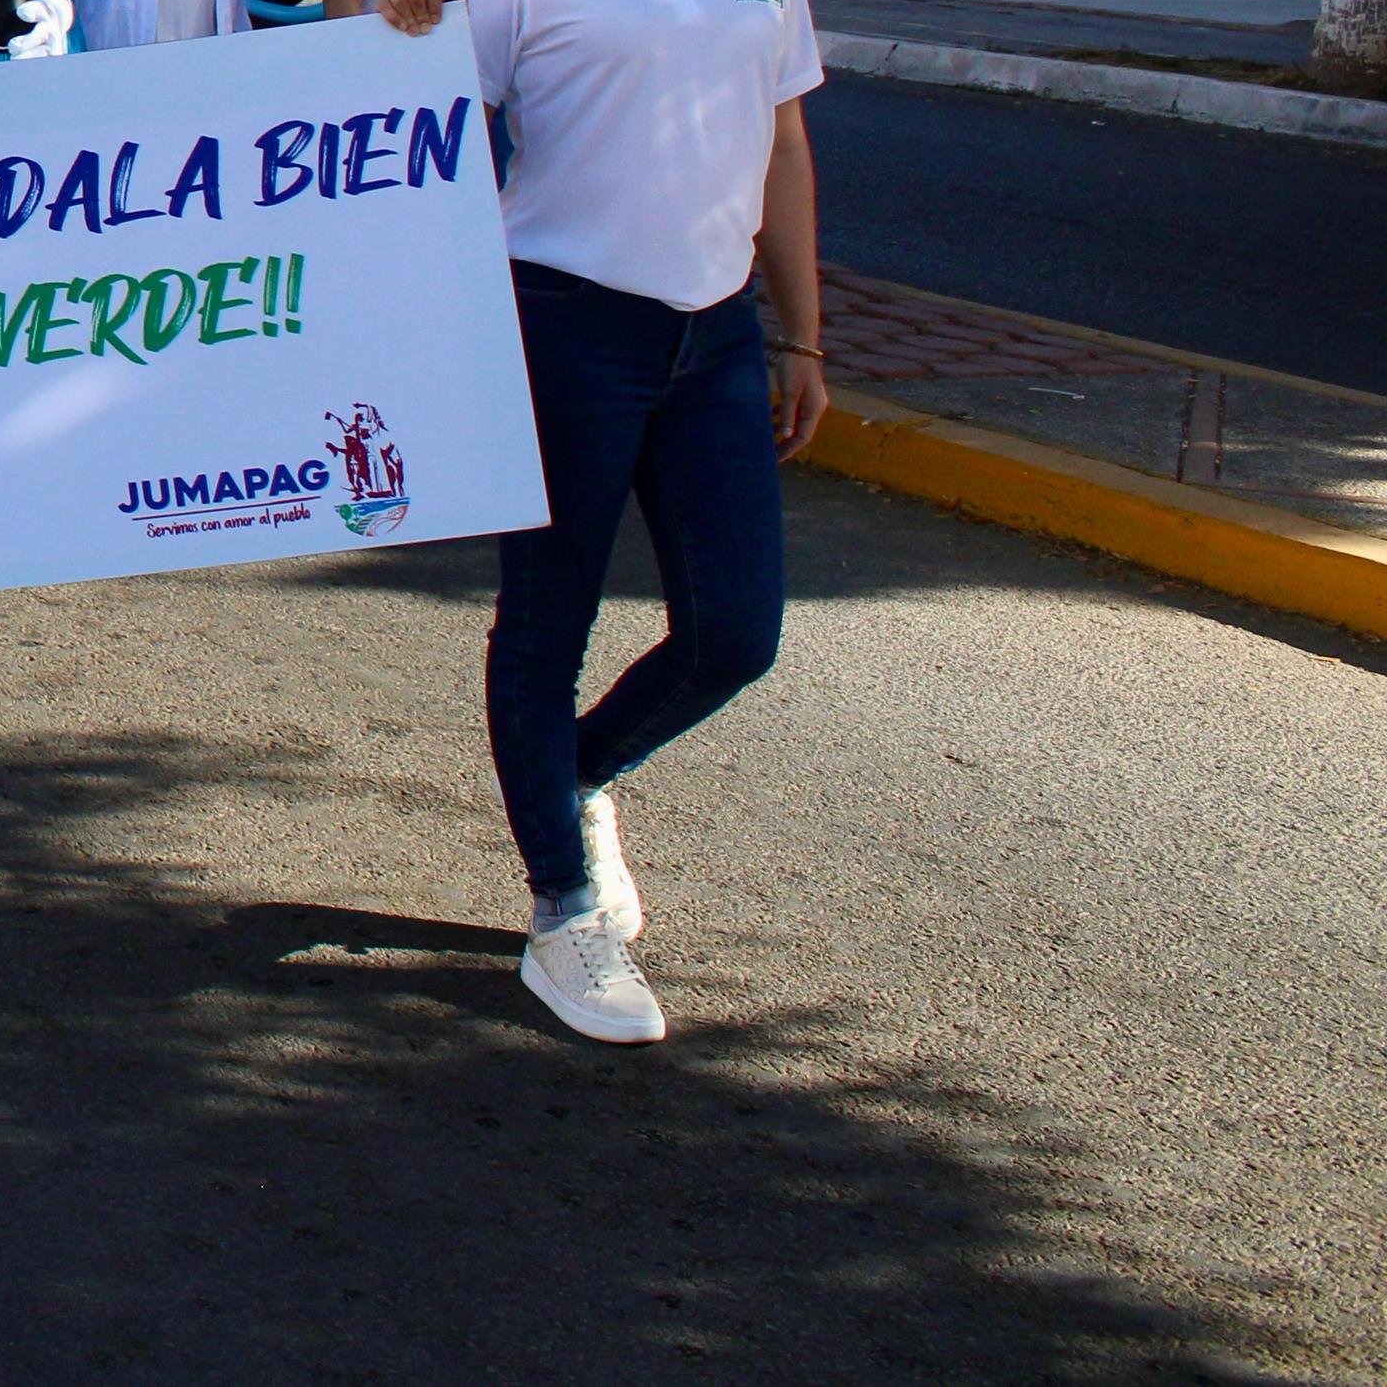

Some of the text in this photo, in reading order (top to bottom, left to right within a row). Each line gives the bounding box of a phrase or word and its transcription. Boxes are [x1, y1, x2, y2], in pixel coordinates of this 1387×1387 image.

[253, 95, 472, 207] BIEN
[117, 459, 330, 515] JUMAPAG
[146, 501, 312, 539] Servimos con amor al pueblo
